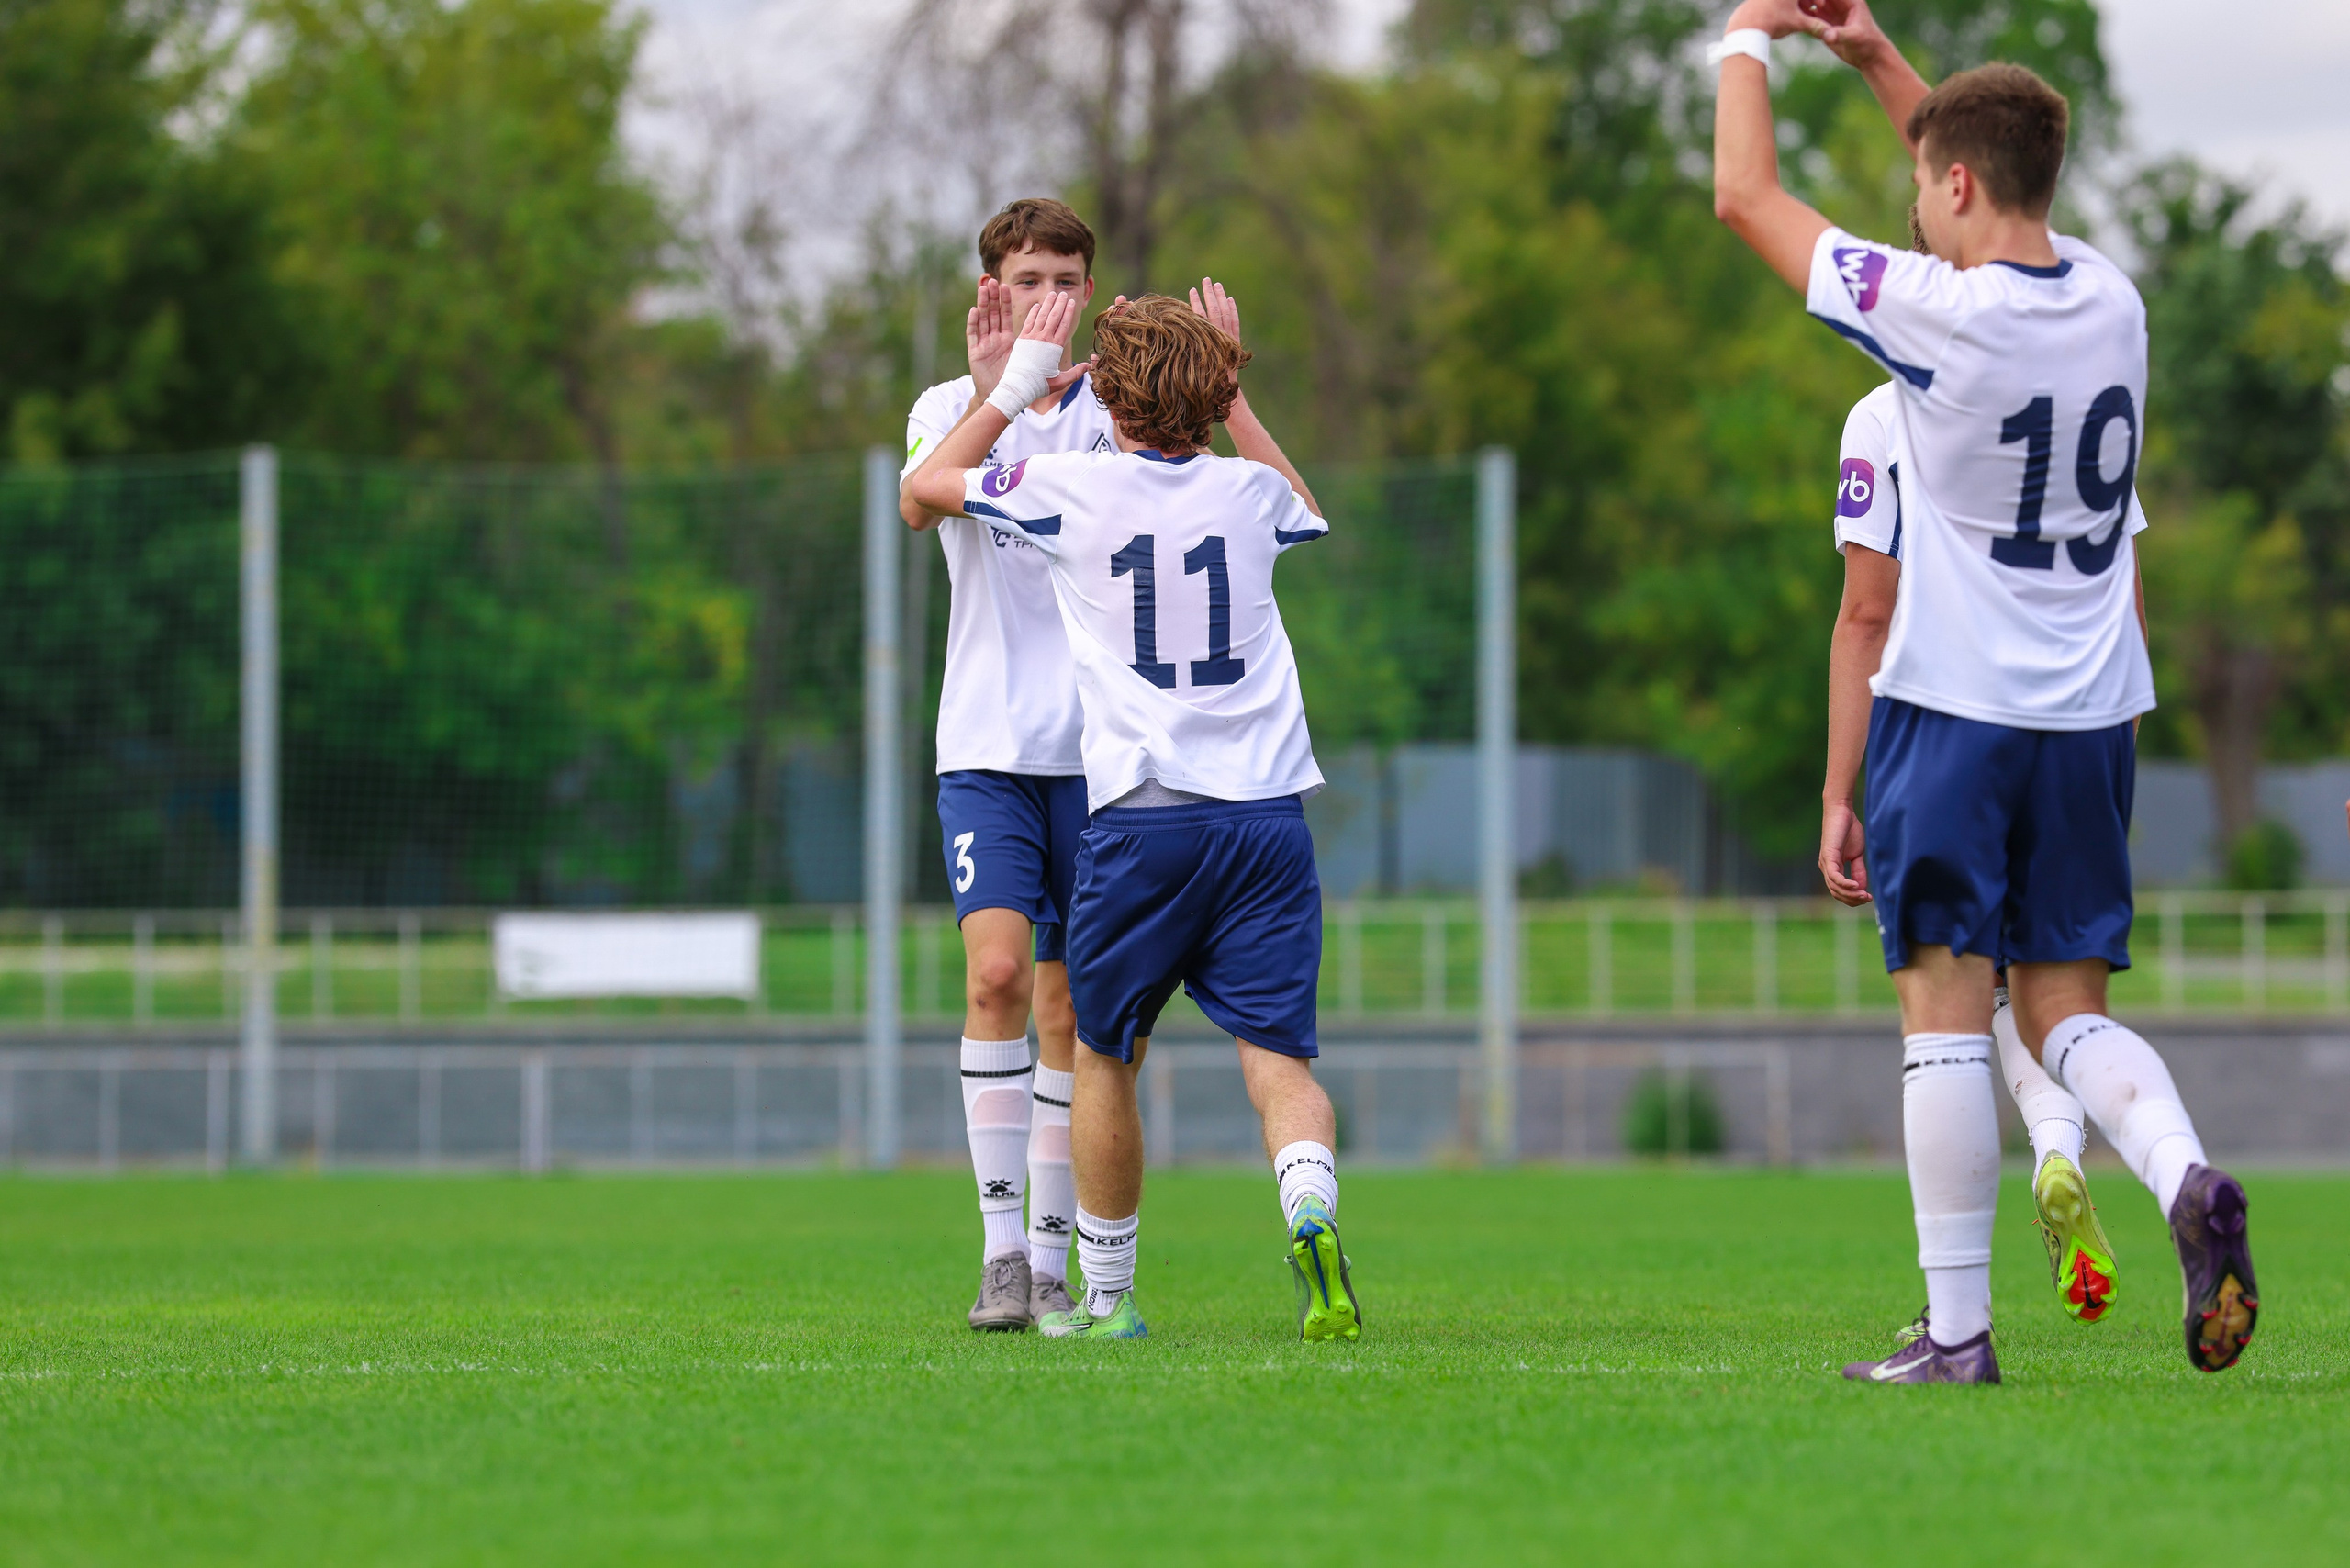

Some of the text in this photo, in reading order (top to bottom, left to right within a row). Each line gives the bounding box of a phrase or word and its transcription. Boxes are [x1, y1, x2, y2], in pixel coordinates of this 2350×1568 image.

[1990, 385, 2137, 576] 19
[1110, 534, 1246, 689] 11
[953, 831, 975, 894] 3
[1286, 1157, 1334, 1176] KELME
[1036, 1226, 1069, 1235] KELME
